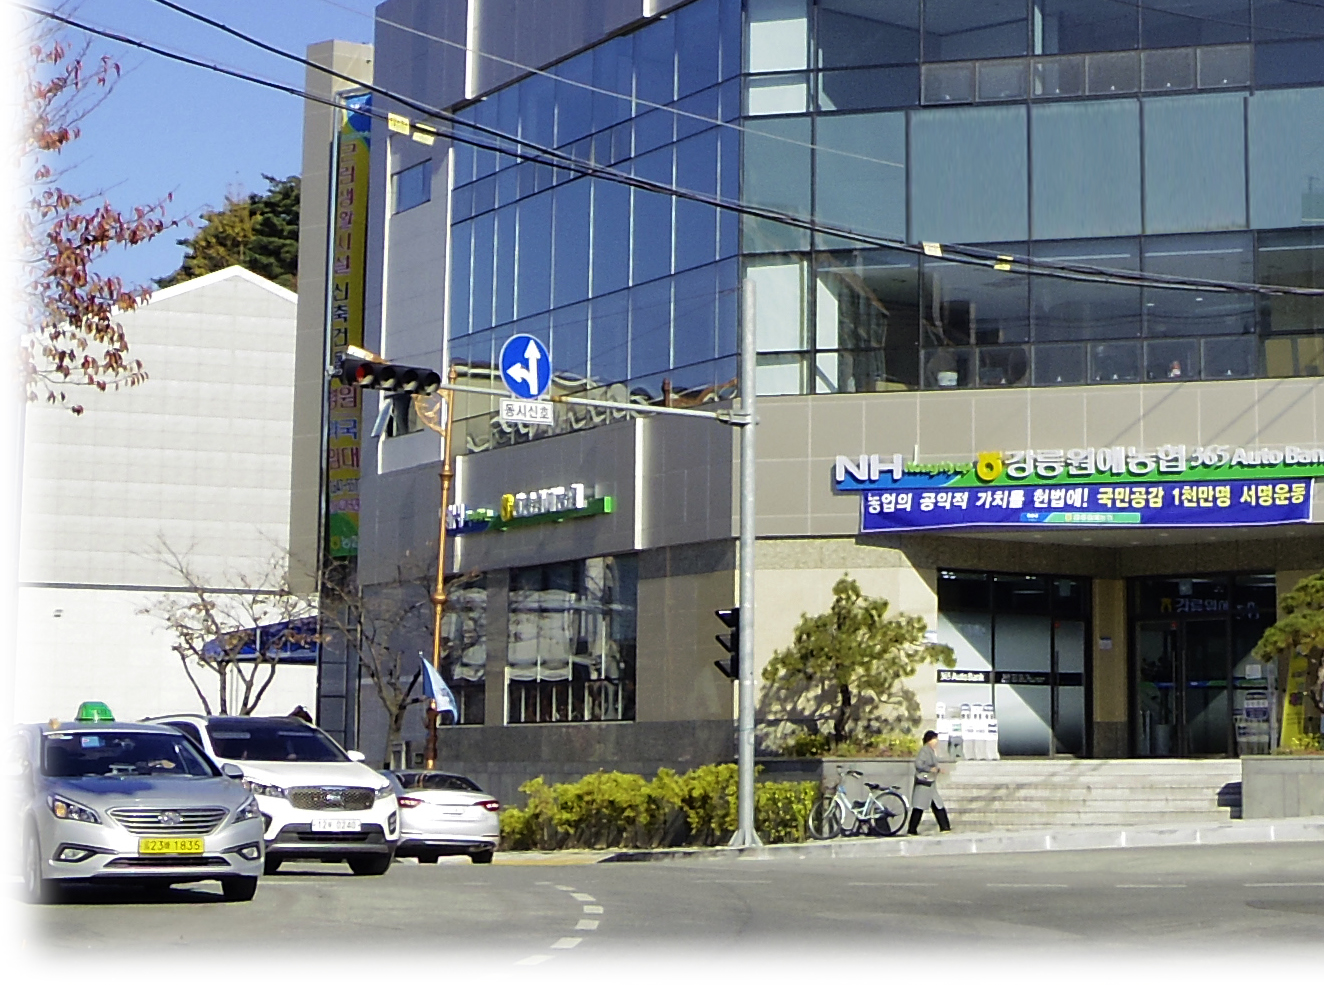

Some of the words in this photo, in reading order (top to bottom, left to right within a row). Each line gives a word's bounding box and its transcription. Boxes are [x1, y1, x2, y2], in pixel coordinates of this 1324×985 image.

[504, 403, 550, 420] 동시신호
[835, 453, 903, 482] NH
[1004, 444, 1186, 478] 강릉원예농협
[1191, 445, 1230, 466] 365
[867, 493, 912, 514] 농업의
[919, 491, 968, 511] 공익적
[975, 490, 1025, 509] 가치를
[1033, 488, 1089, 508] 헌법에!
[1097, 486, 1164, 508] 국민공감
[1172, 485, 1231, 507] 1천만명
[1240, 483, 1307, 506] 서명운동
